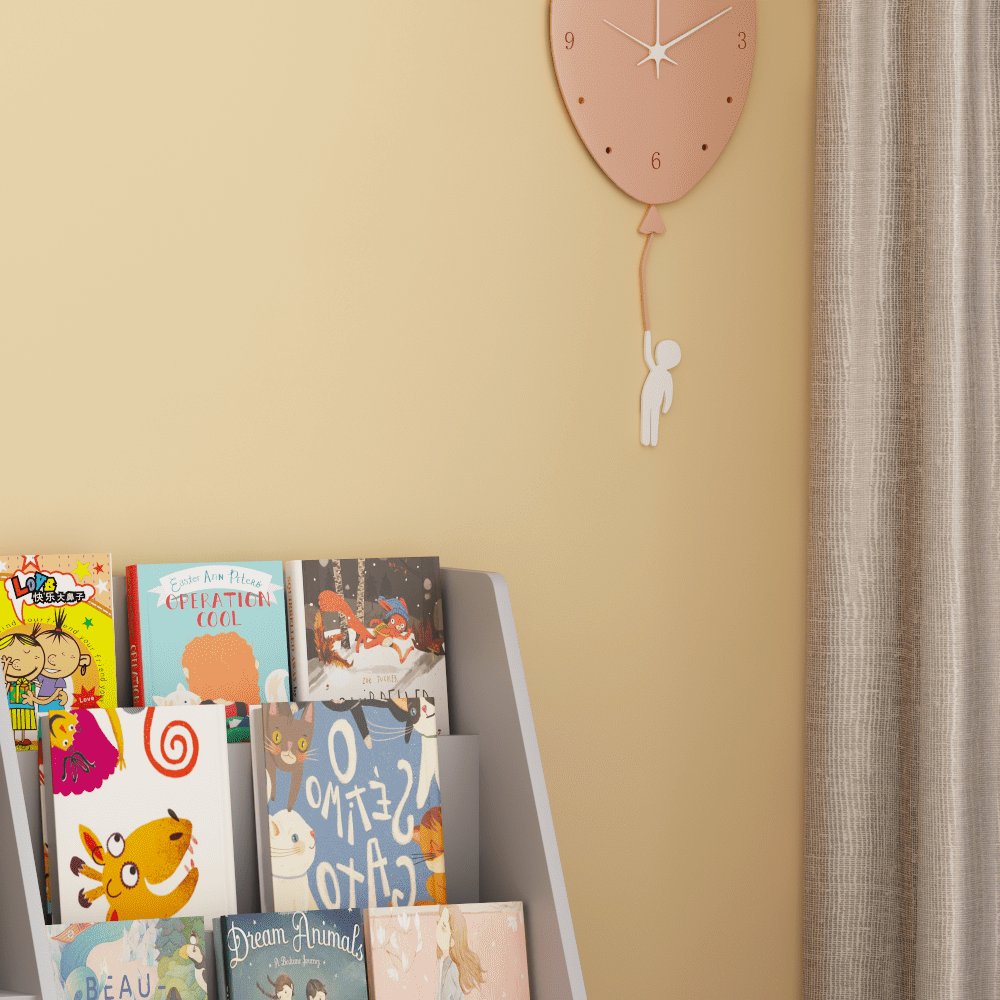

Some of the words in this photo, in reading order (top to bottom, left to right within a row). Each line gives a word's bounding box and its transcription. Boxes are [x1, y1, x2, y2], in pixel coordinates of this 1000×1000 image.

[564, 31, 575, 50] 9
[737, 31, 747, 50] 3
[651, 151, 661, 170] 6
[165, 591, 271, 610] OPERATION
[196, 610, 242, 627] COOL
[227, 921, 289, 969] Dream
[291, 910, 364, 962] Animals
[86, 973, 166, 1000] BEAU-
